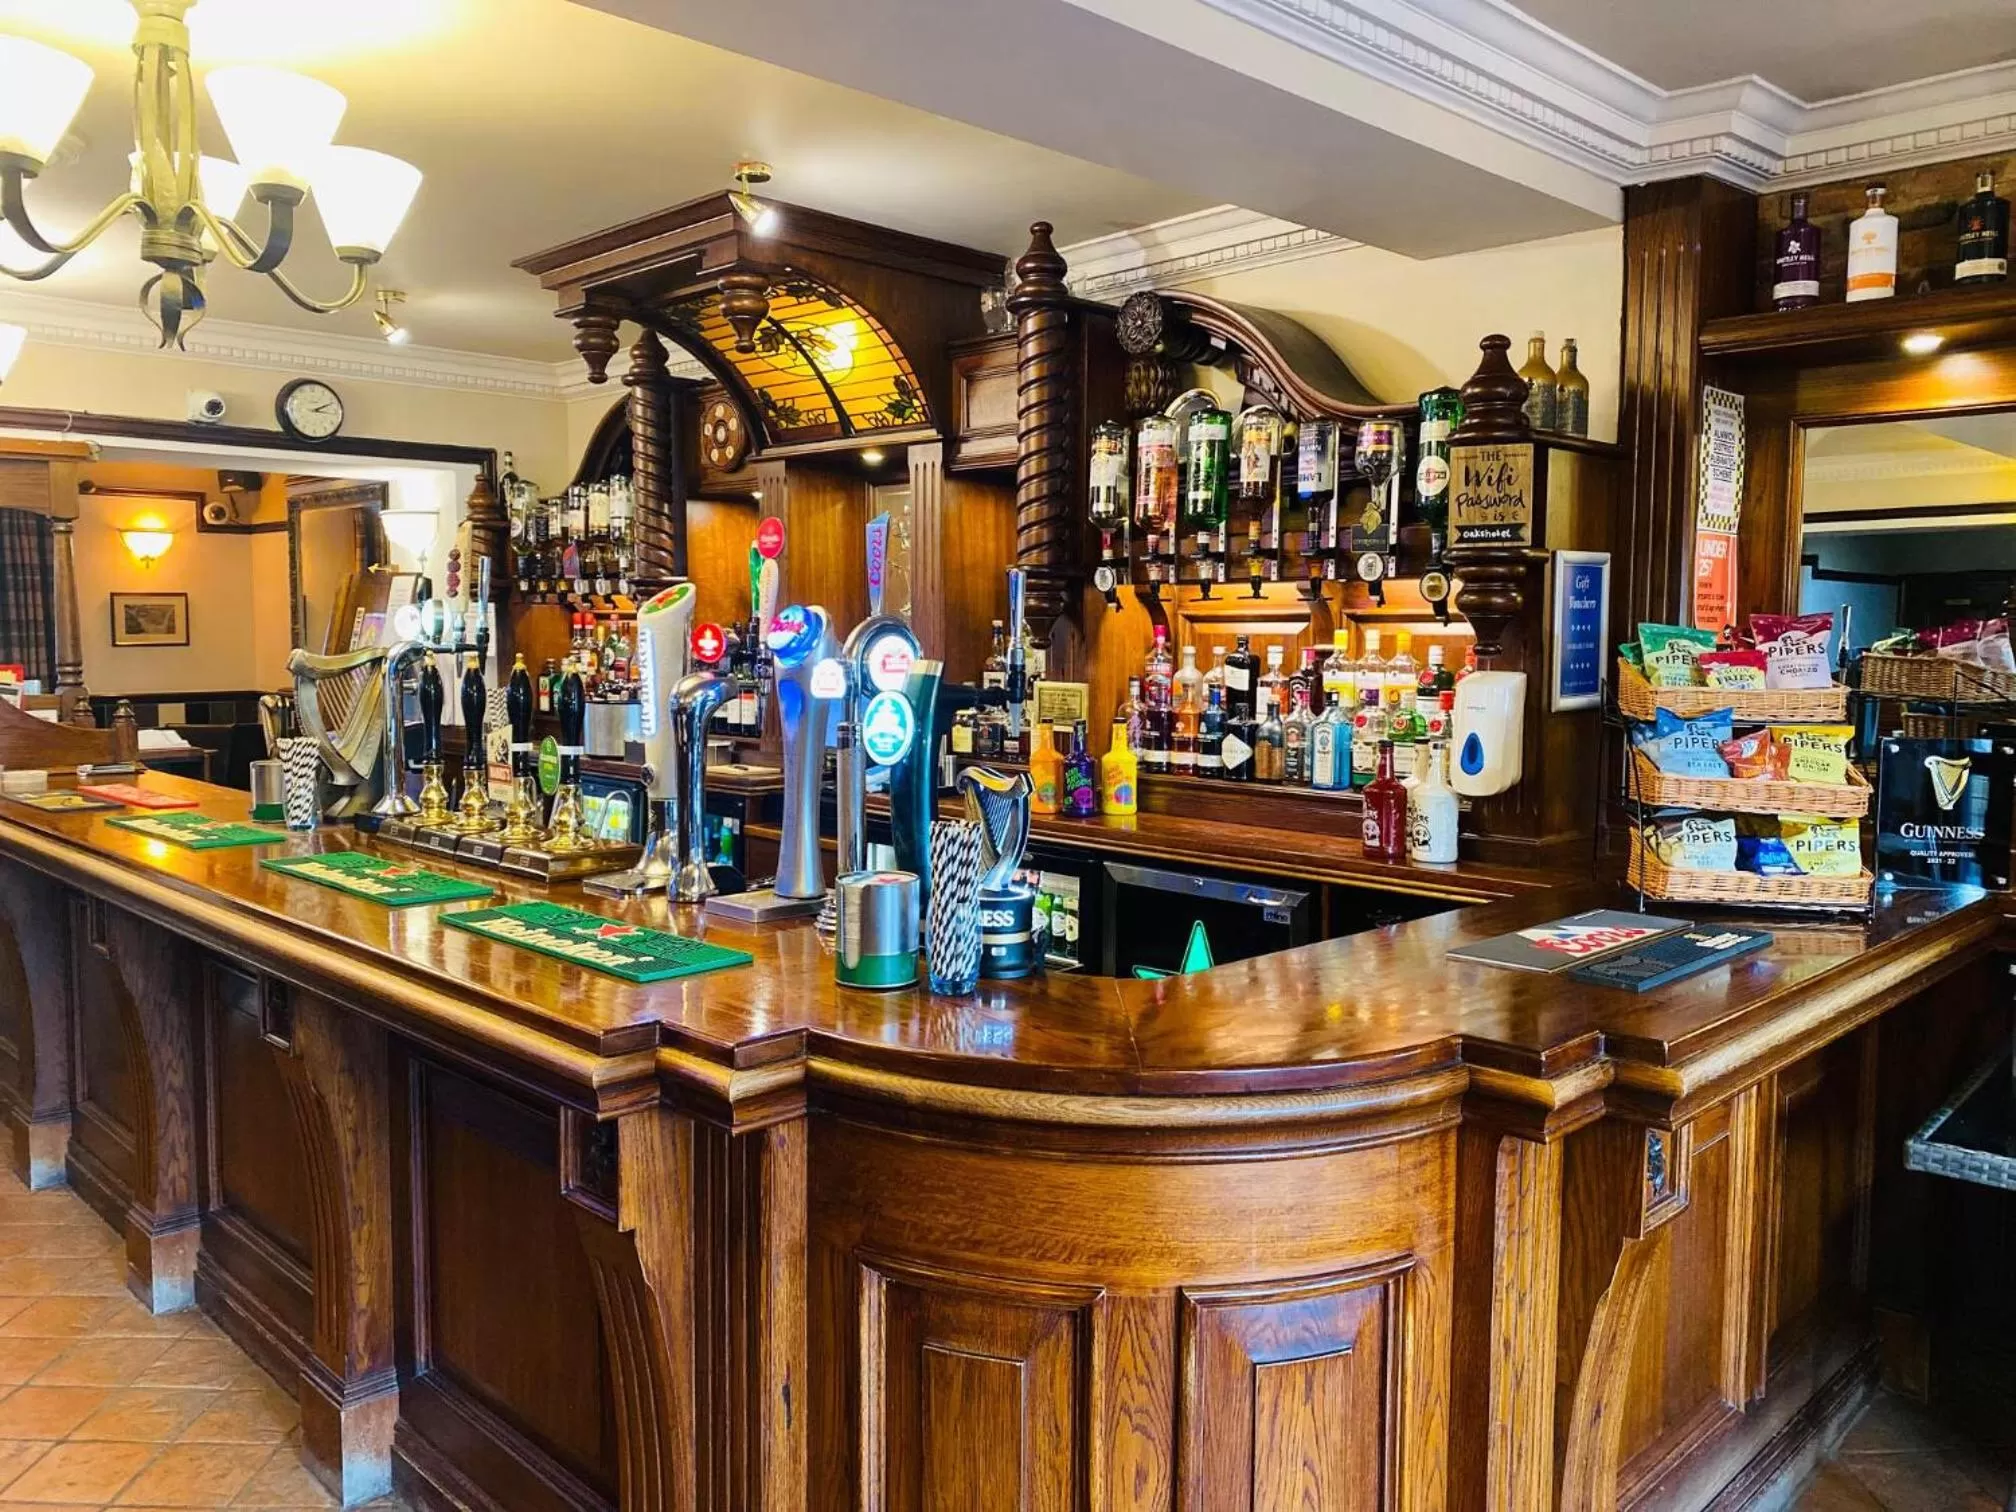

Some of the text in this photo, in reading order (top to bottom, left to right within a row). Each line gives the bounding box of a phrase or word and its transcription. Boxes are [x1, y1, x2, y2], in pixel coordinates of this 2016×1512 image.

[1481, 451, 1502, 461] THE
[1464, 462, 1519, 494] Wifi
[868, 526, 883, 586] Coors
[1575, 574, 1591, 593] Gift
[1768, 642, 1826, 658] PIPERS
[1655, 655, 1698, 666] PIPER
[1783, 737, 1843, 754] PIPERS
[1900, 822, 1986, 840] GUINNESS
[1796, 839, 1857, 853] PIPERS
[1530, 925, 1646, 954] Coors
